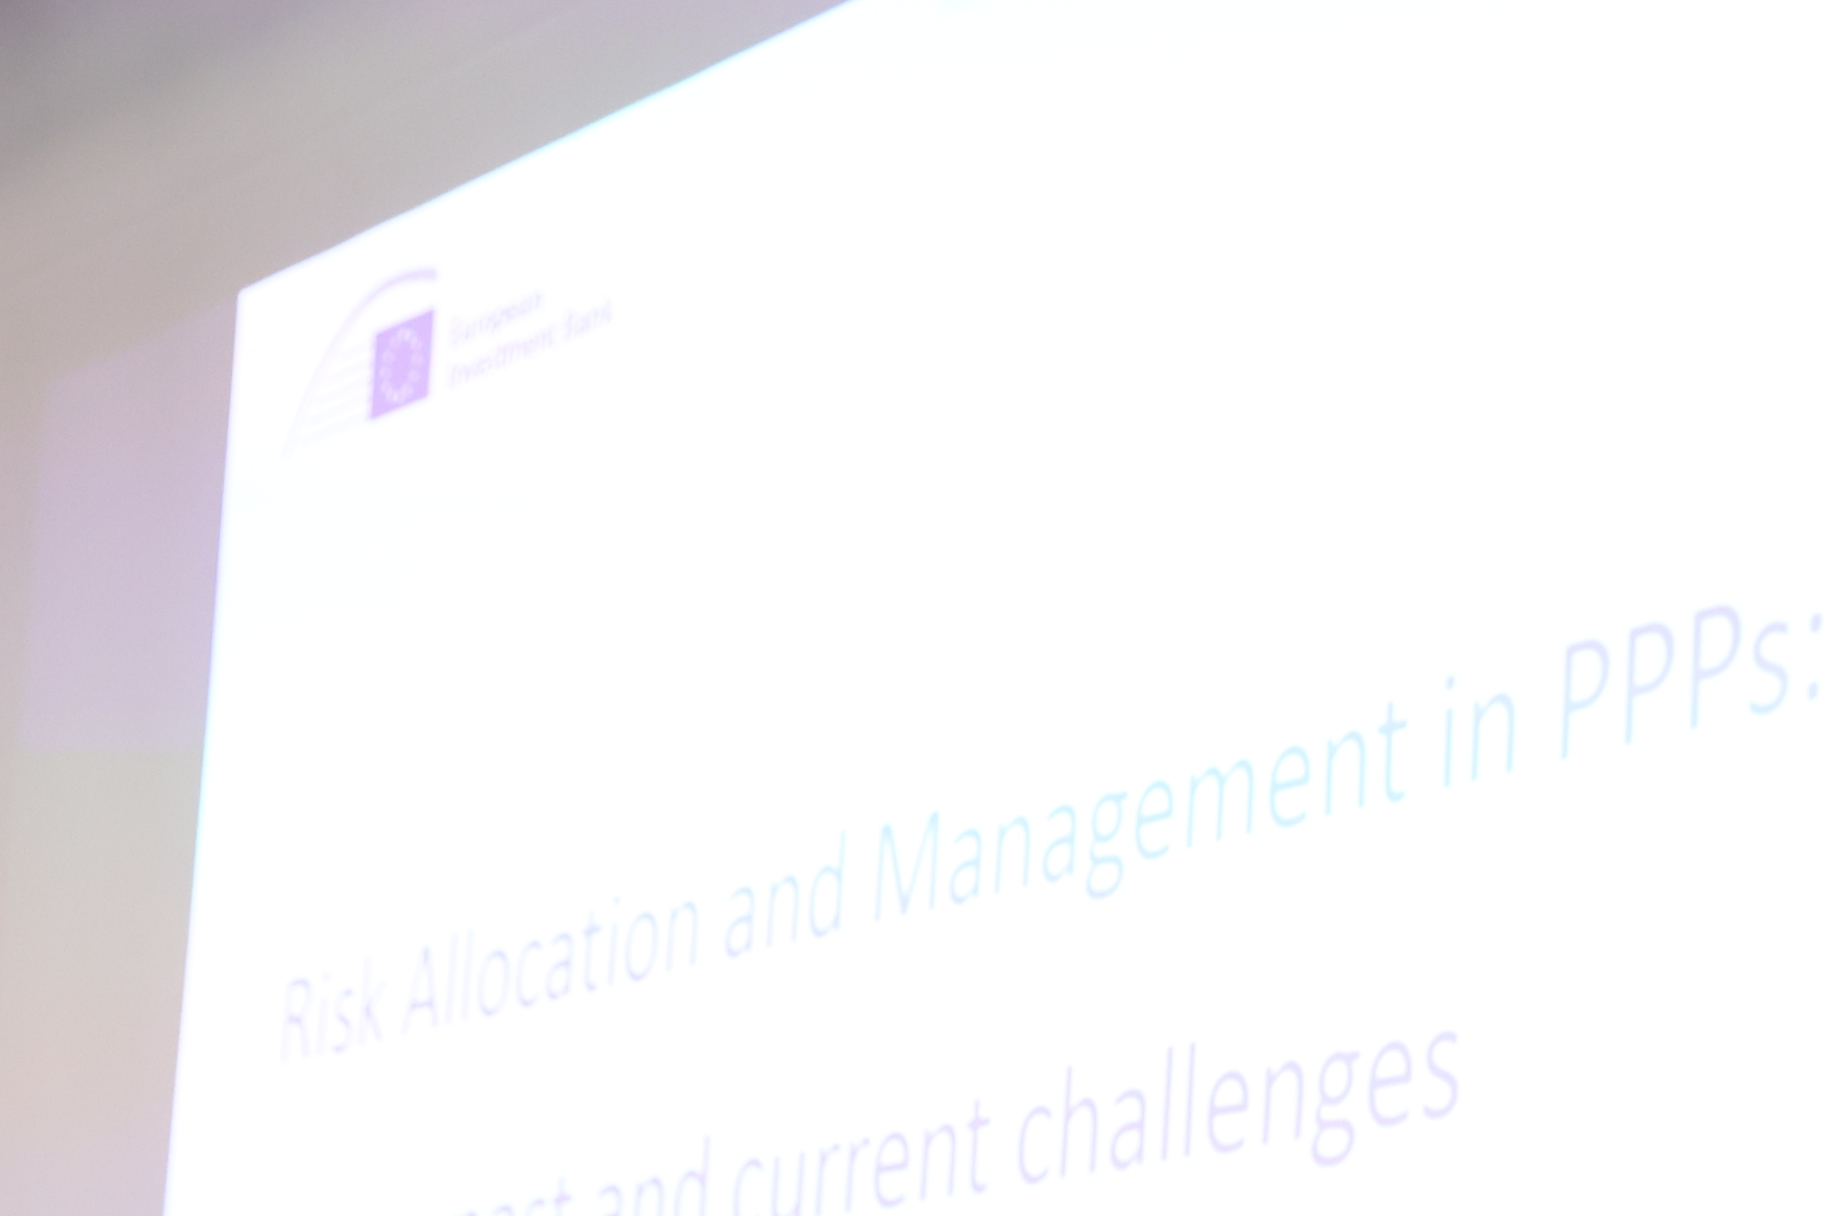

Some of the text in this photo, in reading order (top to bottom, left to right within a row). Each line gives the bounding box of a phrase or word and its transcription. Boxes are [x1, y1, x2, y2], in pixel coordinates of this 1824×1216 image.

[280, 602, 1824, 1062] Risk Allocation and Management in PPPs:
[1017, 1030, 1459, 1185] challenges
